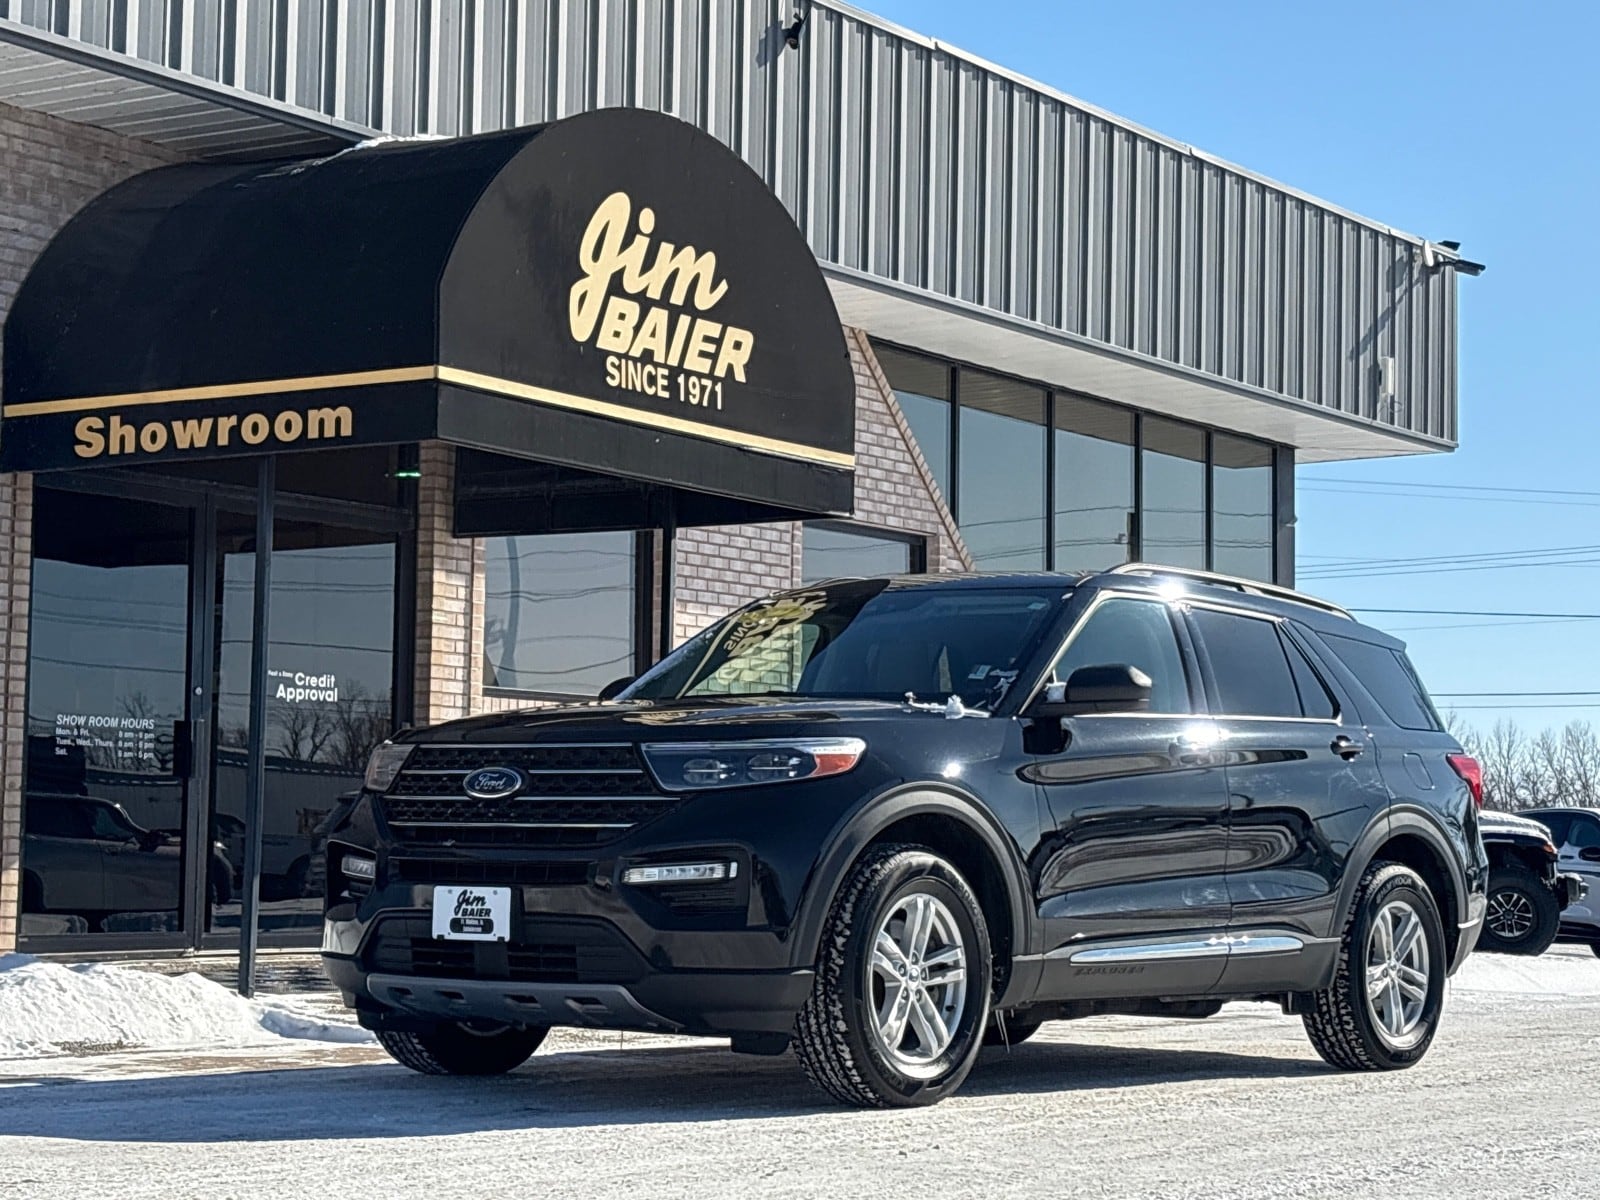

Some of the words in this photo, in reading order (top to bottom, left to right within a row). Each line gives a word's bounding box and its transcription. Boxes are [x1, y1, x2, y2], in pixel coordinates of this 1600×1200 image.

[569, 191, 729, 343] Jim
[595, 295, 754, 383] BAIER
[605, 355, 670, 399] SINCE
[677, 373, 723, 410] 1971
[74, 405, 353, 458] Showroom
[295, 672, 336, 688] Credit
[275, 683, 338, 703] Approval
[56, 714, 87, 726] SHOW
[88, 716, 119, 728] ROOM
[120, 718, 155, 729] HOURS
[474, 773, 507, 790] Ford
[454, 889, 487, 916] Jim
[461, 908, 492, 917] BAIER
